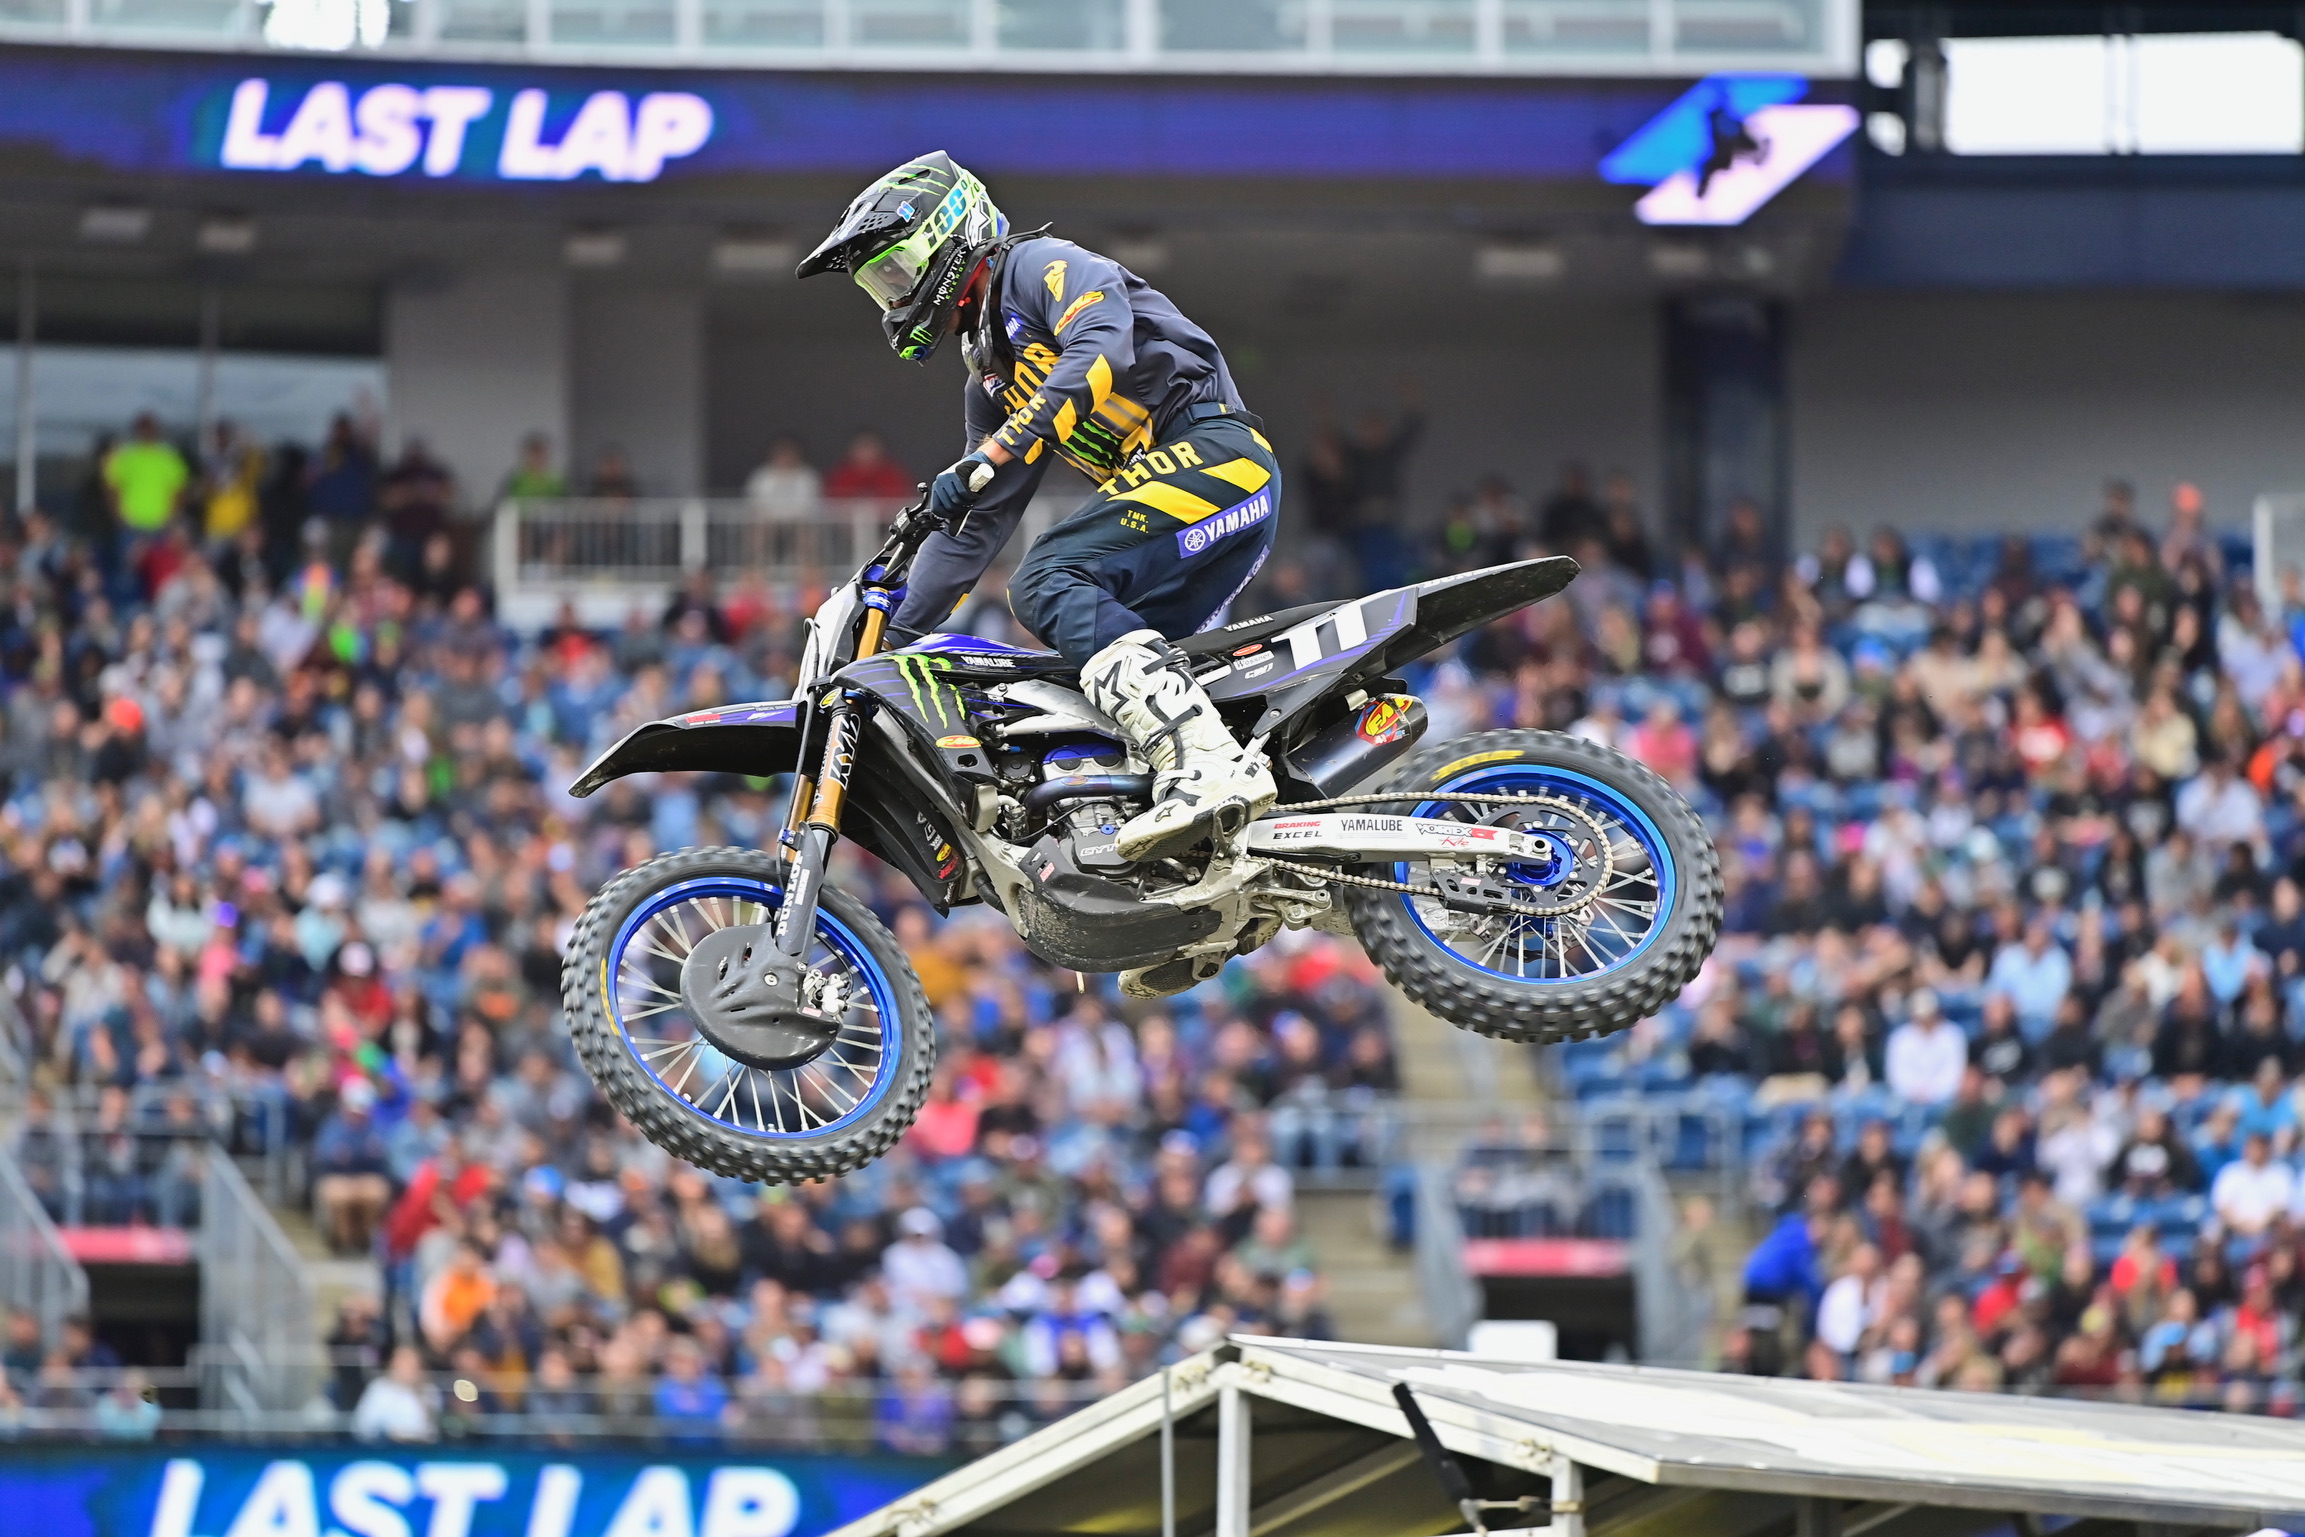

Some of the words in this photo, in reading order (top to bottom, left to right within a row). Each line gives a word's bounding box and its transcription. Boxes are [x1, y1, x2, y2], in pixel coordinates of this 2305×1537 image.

[221, 77, 492, 176] LAST
[498, 89, 715, 183] LAP
[921, 173, 980, 249] 100%
[1097, 441, 1204, 496] THOR
[1203, 494, 1270, 543] YAMAHA
[1223, 615, 1275, 632] YAMAHA
[960, 655, 1017, 668] YAMALUBE
[1273, 820, 1321, 829] BRAKING
[1341, 819, 1403, 831] YAMALUBE
[1415, 822, 1474, 838] VORTEX
[1273, 831, 1322, 840] EXCEL
[1080, 843, 1118, 857] GYT
[149, 1457, 508, 1537] LAST
[526, 1463, 802, 1537] LAP
